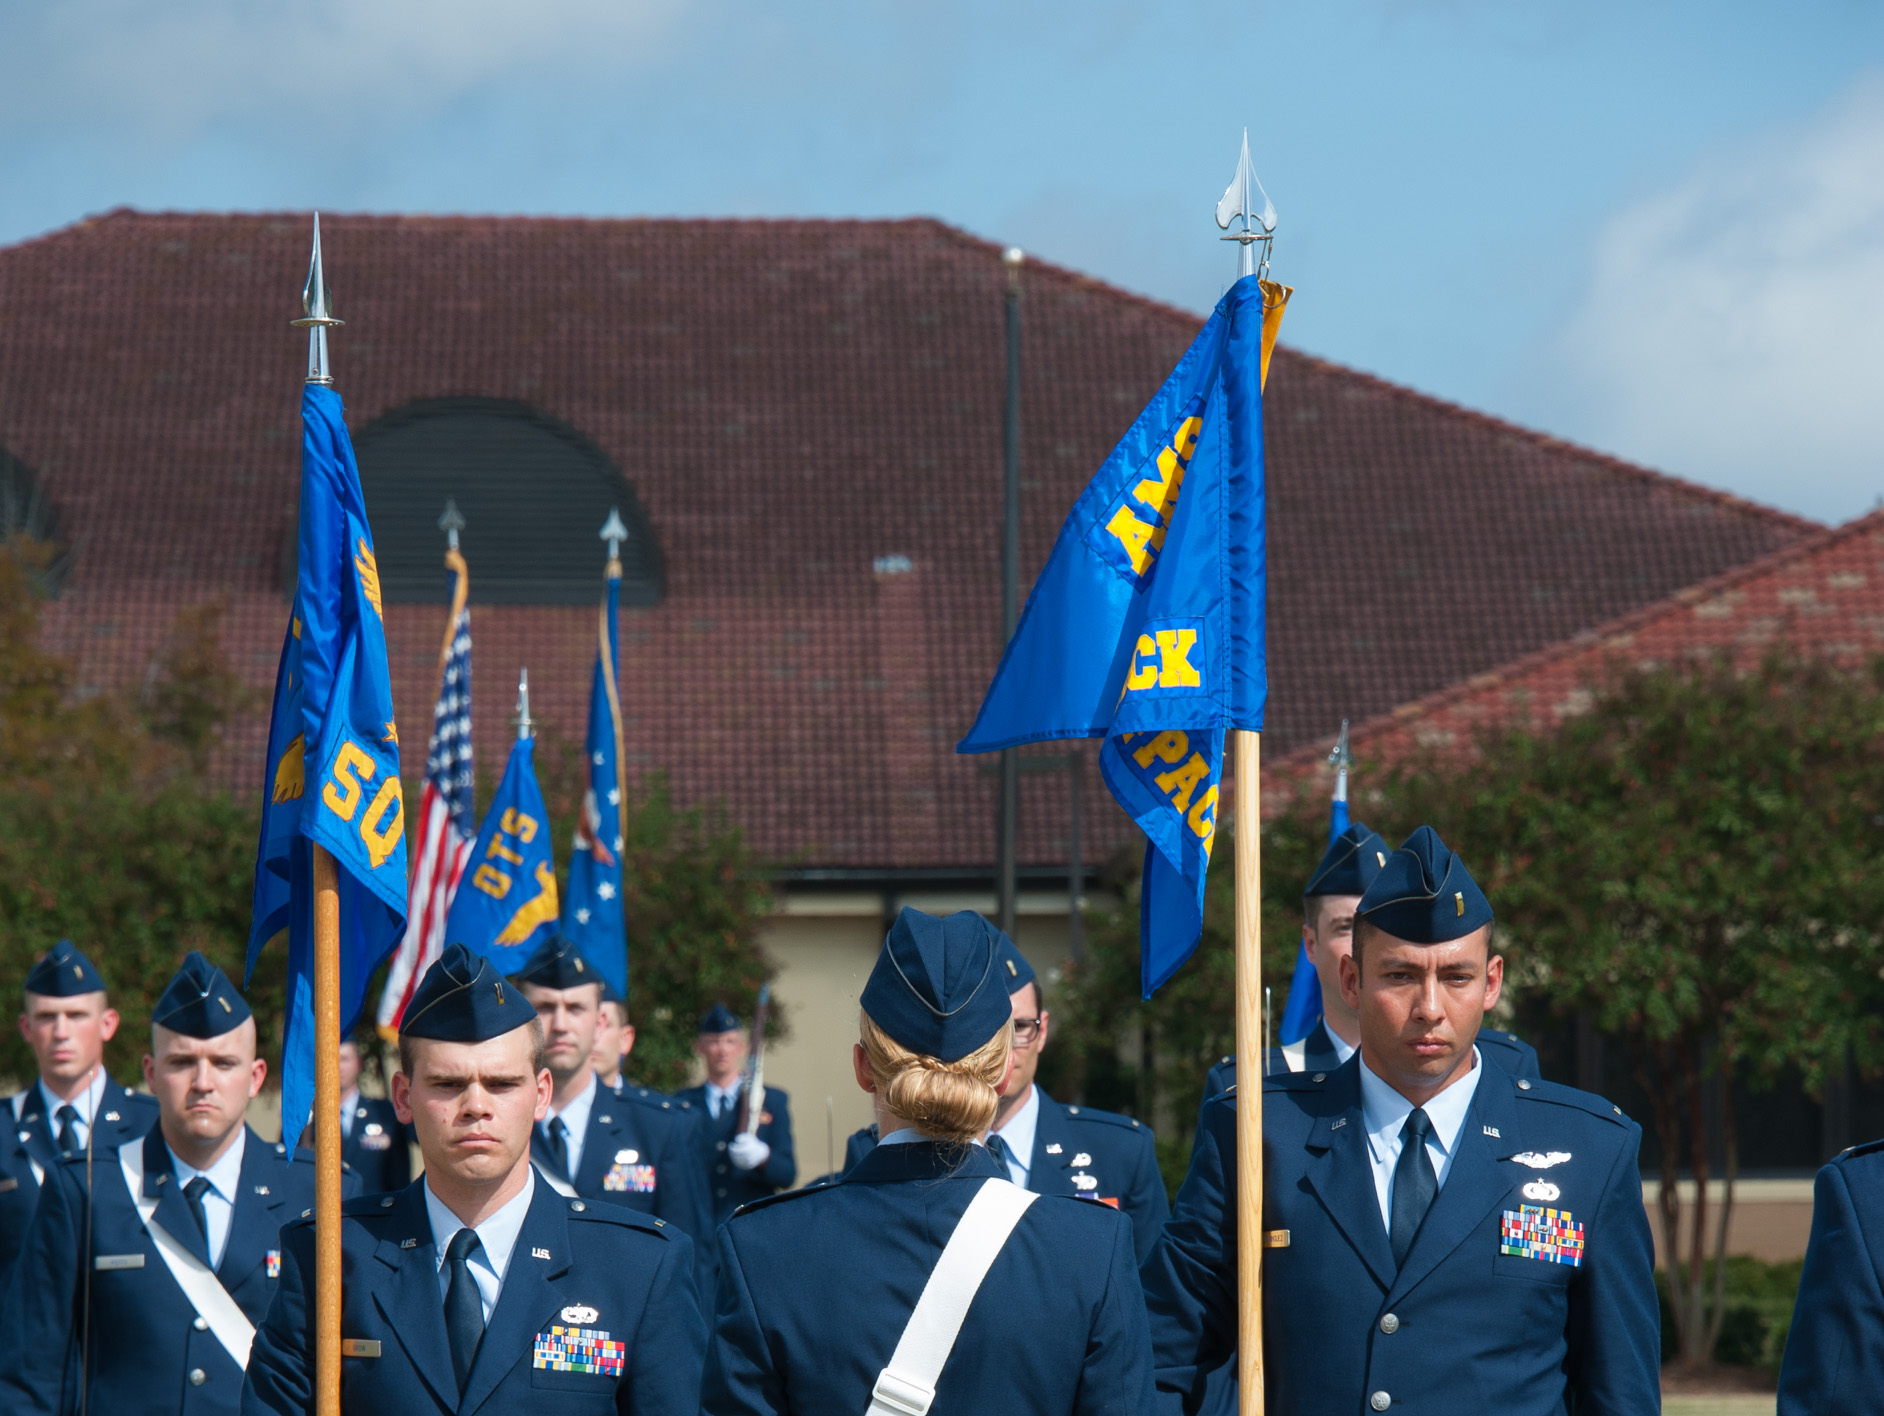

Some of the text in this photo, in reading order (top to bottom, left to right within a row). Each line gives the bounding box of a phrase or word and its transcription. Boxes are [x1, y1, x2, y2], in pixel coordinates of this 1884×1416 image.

[1121, 629, 1201, 694] CK
[322, 740, 405, 870] SQ
[472, 806, 539, 900] OTS
